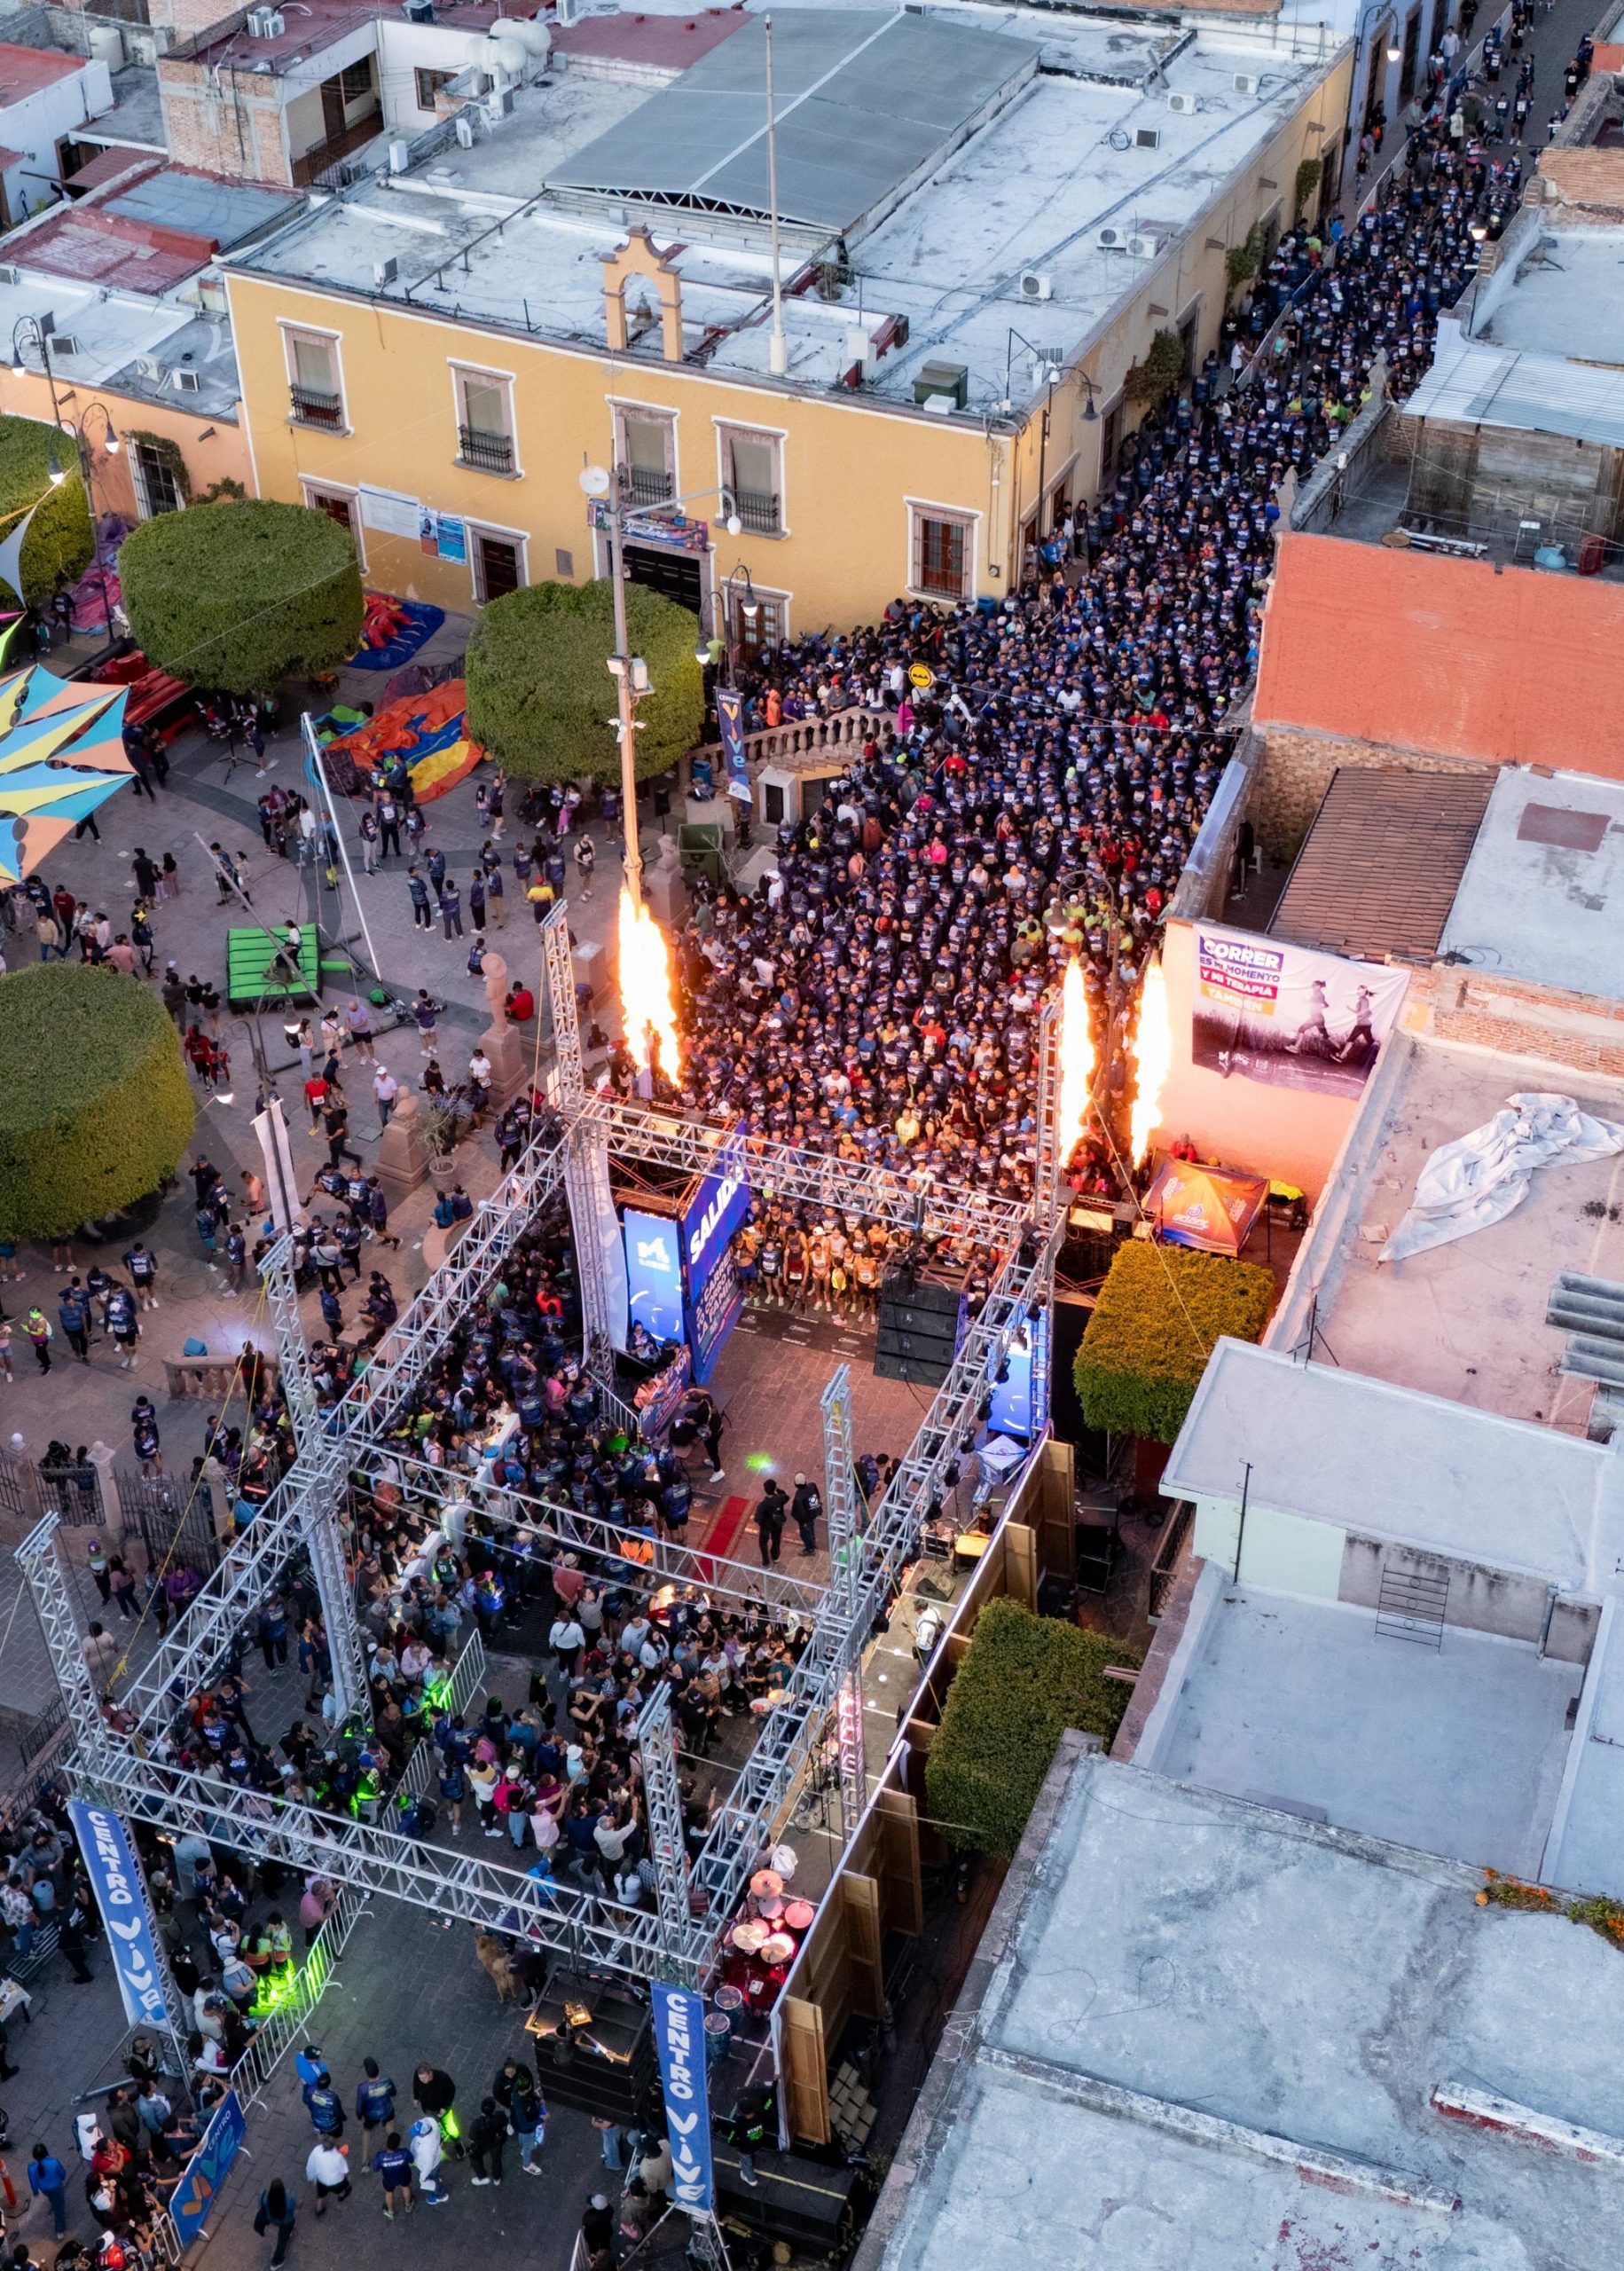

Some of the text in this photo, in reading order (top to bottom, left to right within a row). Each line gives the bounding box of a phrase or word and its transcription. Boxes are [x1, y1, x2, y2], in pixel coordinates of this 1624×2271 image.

[718, 694, 739, 704] CENTRO
[1200, 956, 1212, 965] ES
[1226, 964, 1280, 982] MOMENTO
[1203, 940, 1280, 969] CORRER
[1201, 970, 1273, 996] Y MI TERAPIA
[709, 1269, 735, 1323] FAMILI
[88, 1811, 132, 1905] CENTRO
[666, 1992, 694, 2099] CENTRO
[208, 2110, 231, 2151] CENTRO
